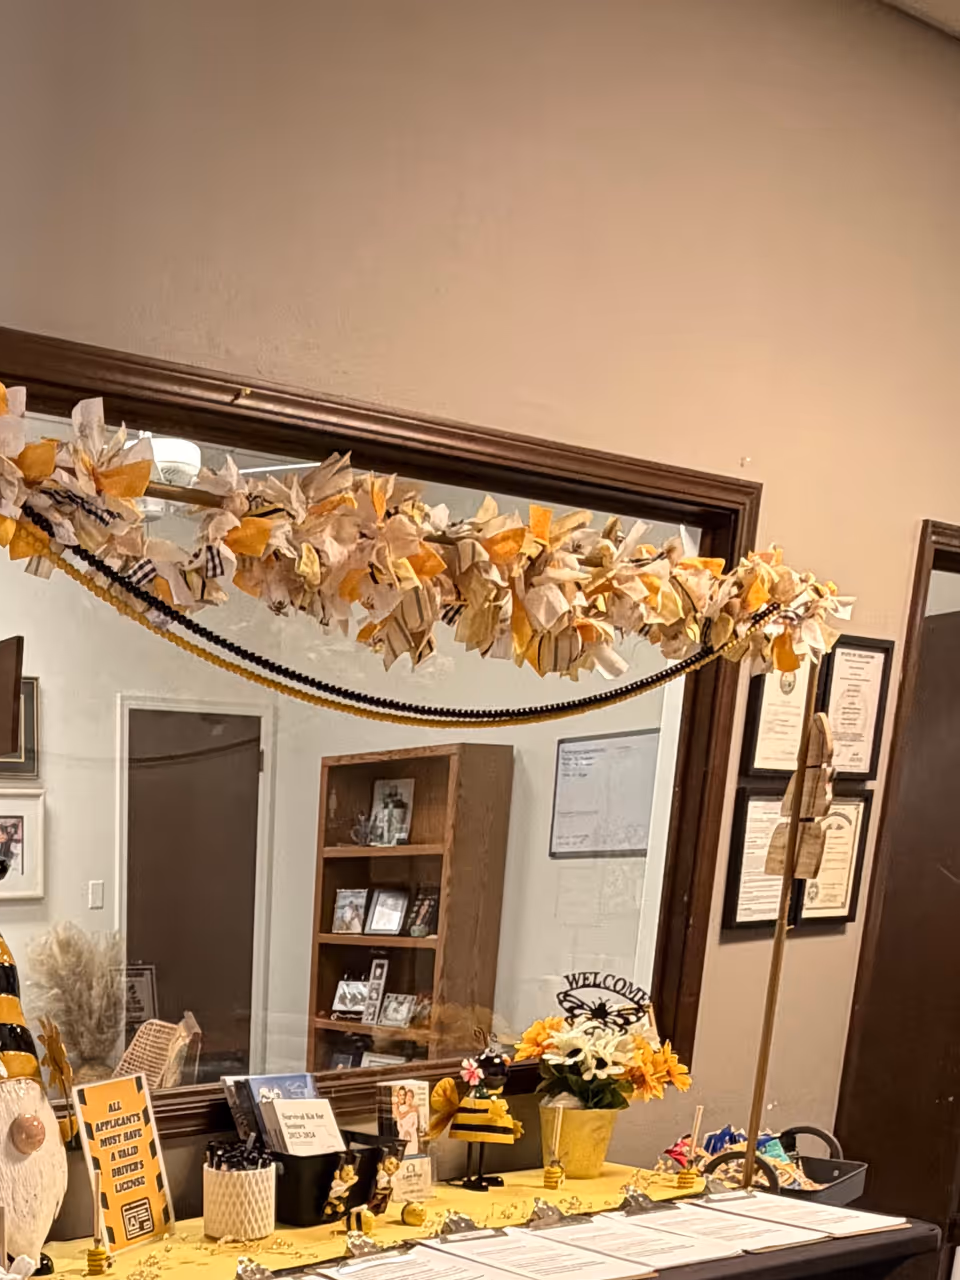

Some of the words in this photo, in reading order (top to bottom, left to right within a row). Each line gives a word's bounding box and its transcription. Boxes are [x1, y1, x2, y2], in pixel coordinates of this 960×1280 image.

[563, 971, 651, 1006] WELCOME
[108, 1101, 122, 1113] ALL
[95, 1112, 141, 1133] APPLICANTS
[100, 1133, 122, 1148] MUST
[123, 1128, 143, 1143] HAVE
[110, 1152, 117, 1162] A
[117, 1145, 139, 1159] VALID
[115, 1176, 145, 1194] LICENSE
